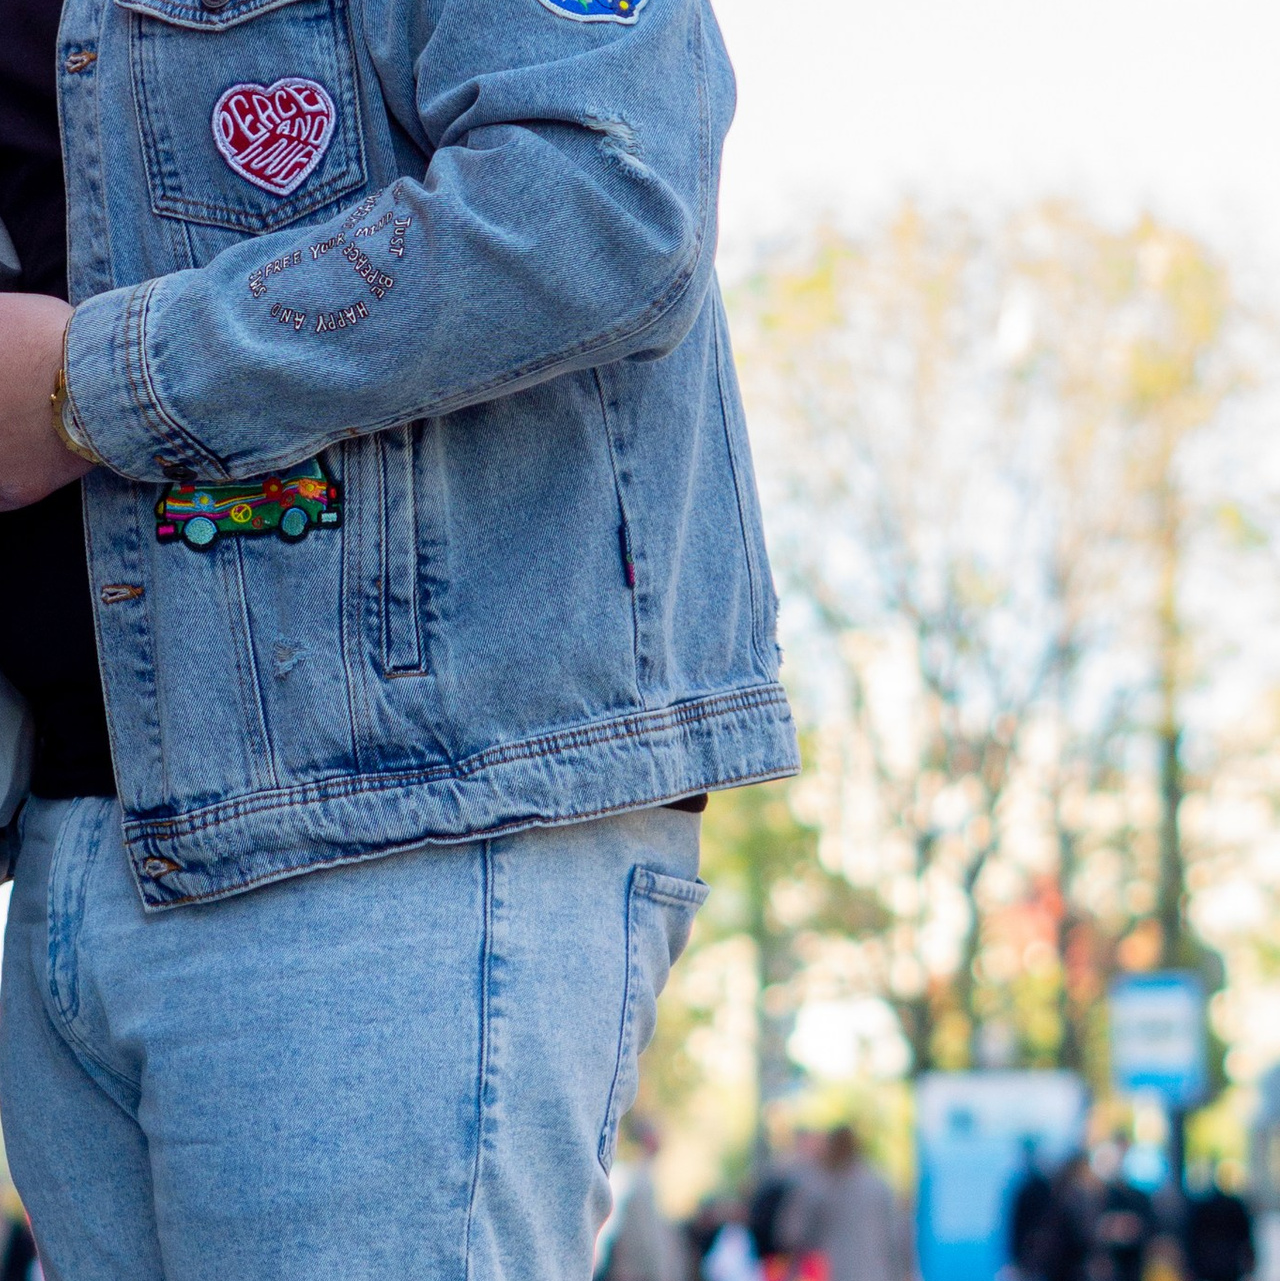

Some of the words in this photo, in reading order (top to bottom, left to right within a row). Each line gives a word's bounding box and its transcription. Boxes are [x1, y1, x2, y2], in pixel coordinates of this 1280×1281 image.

[220, 85, 328, 156] PEACE
[276, 115, 328, 145] AND
[232, 132, 317, 185] LOVE
[264, 249, 302, 278] FREE
[308, 231, 347, 260] YOUR
[354, 211, 394, 238] MIND
[389, 216, 412, 258] JUST
[342, 241, 380, 285] PEACE
[369, 273, 395, 299] BE
[270, 302, 306, 331] AND
[315, 300, 370, 333] HAPPY
